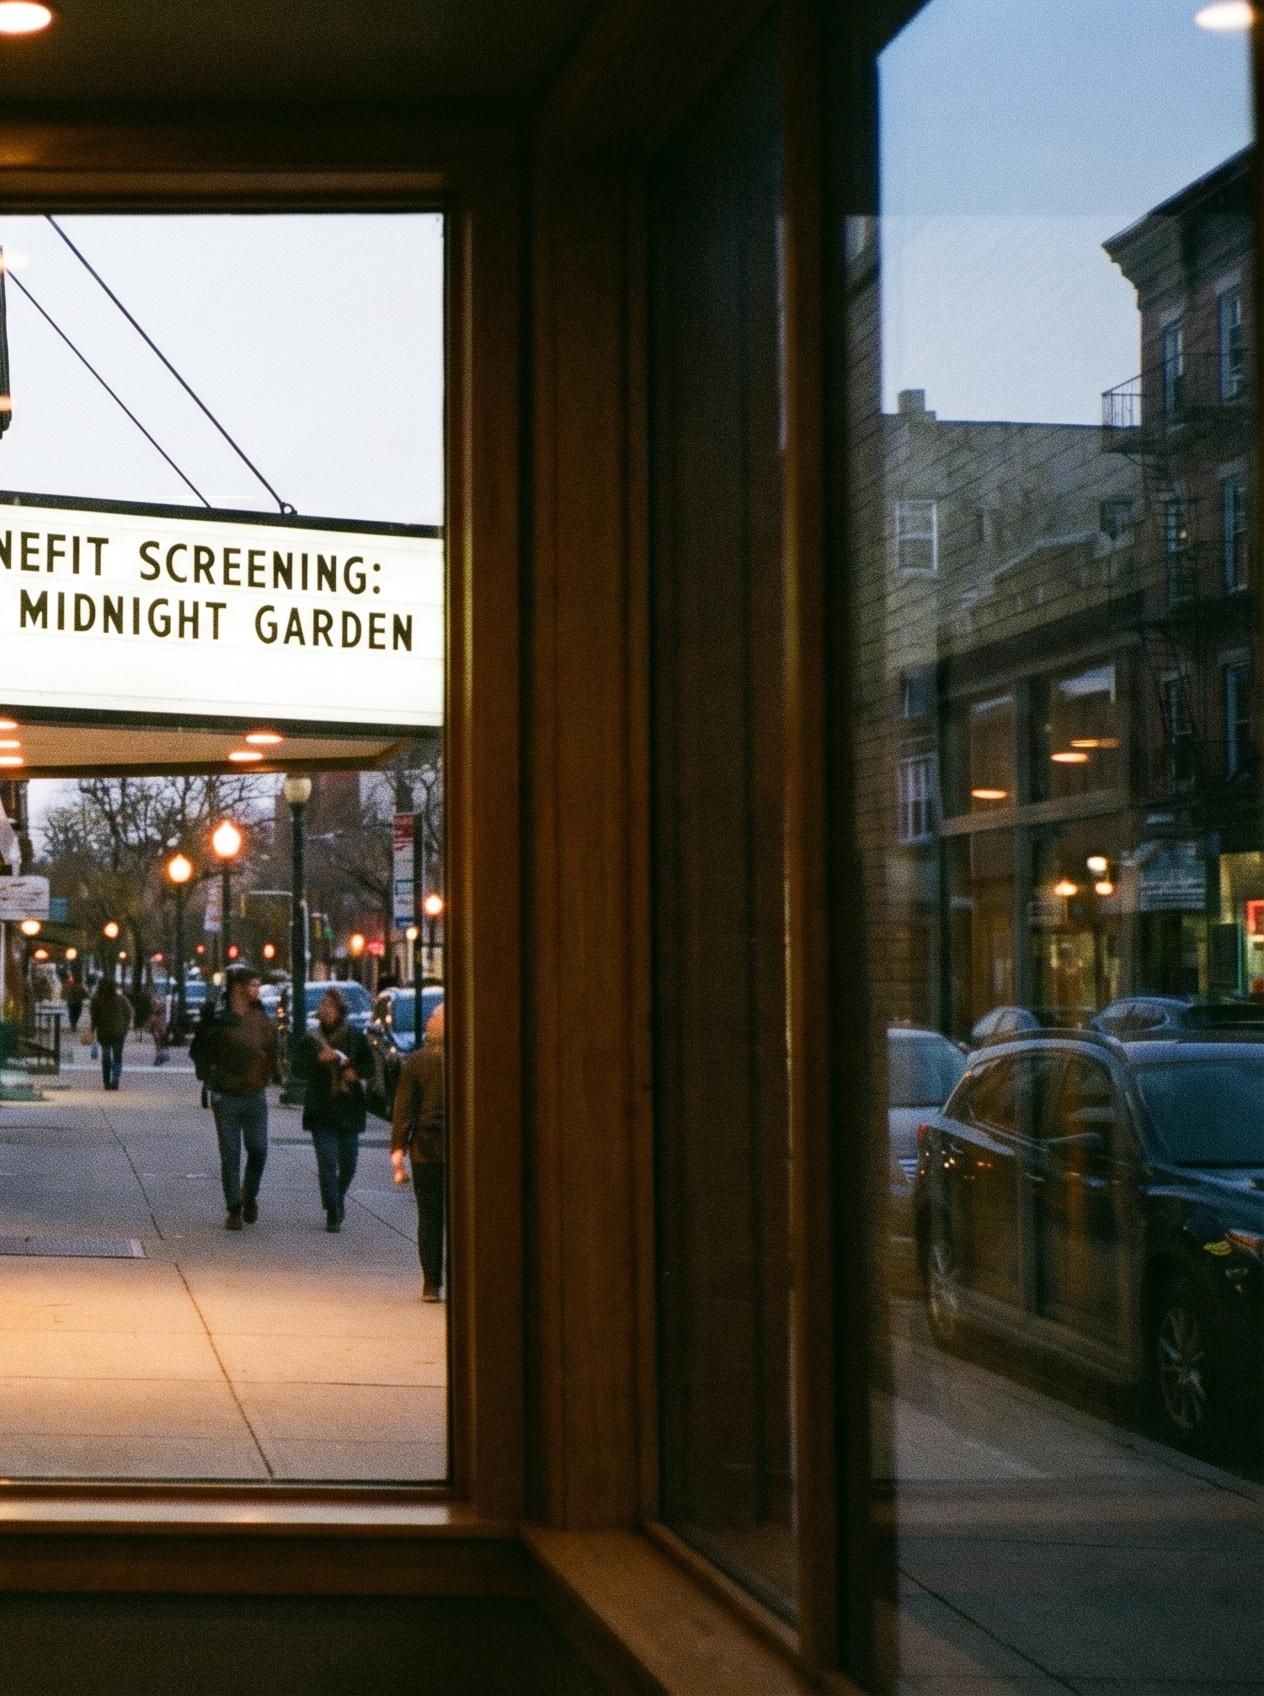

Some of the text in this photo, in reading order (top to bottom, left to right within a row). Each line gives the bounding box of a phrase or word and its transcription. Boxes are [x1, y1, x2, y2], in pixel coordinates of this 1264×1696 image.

[139, 541, 381, 595] SCREENING:
[20, 589, 227, 640] MIDNIGHT
[255, 604, 414, 652] GARDEN
